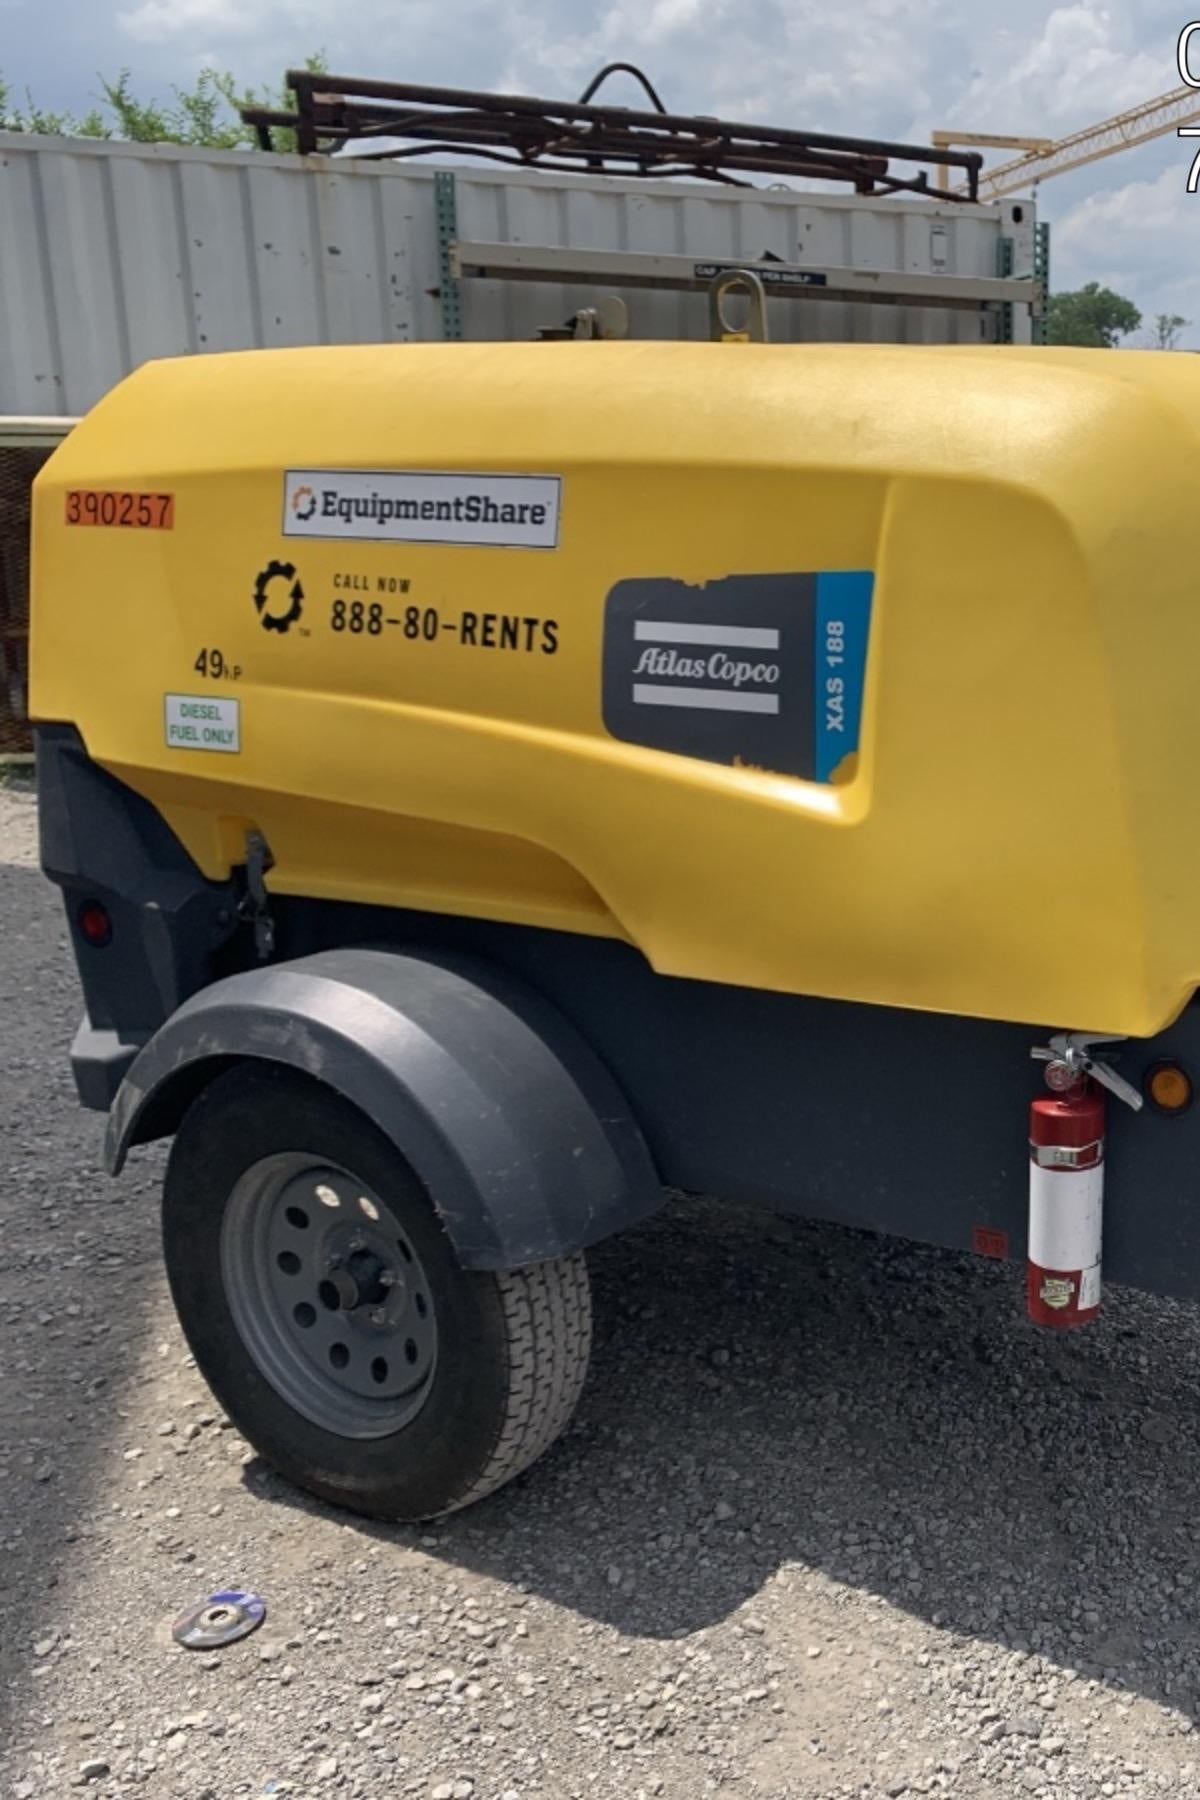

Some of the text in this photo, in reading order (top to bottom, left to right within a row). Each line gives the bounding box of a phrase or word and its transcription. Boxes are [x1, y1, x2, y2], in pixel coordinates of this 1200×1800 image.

[66, 491, 173, 529] 390257
[321, 490, 547, 526] EquipmentShare
[333, 573, 411, 595] CALL NOW
[331, 599, 560, 655] 888-80-RENTS
[632, 648, 780, 688] Atlas Copco
[826, 620, 845, 733] XAS 188
[180, 703, 222, 721] DIESEL
[169, 725, 235, 744] FUEL ONLY
